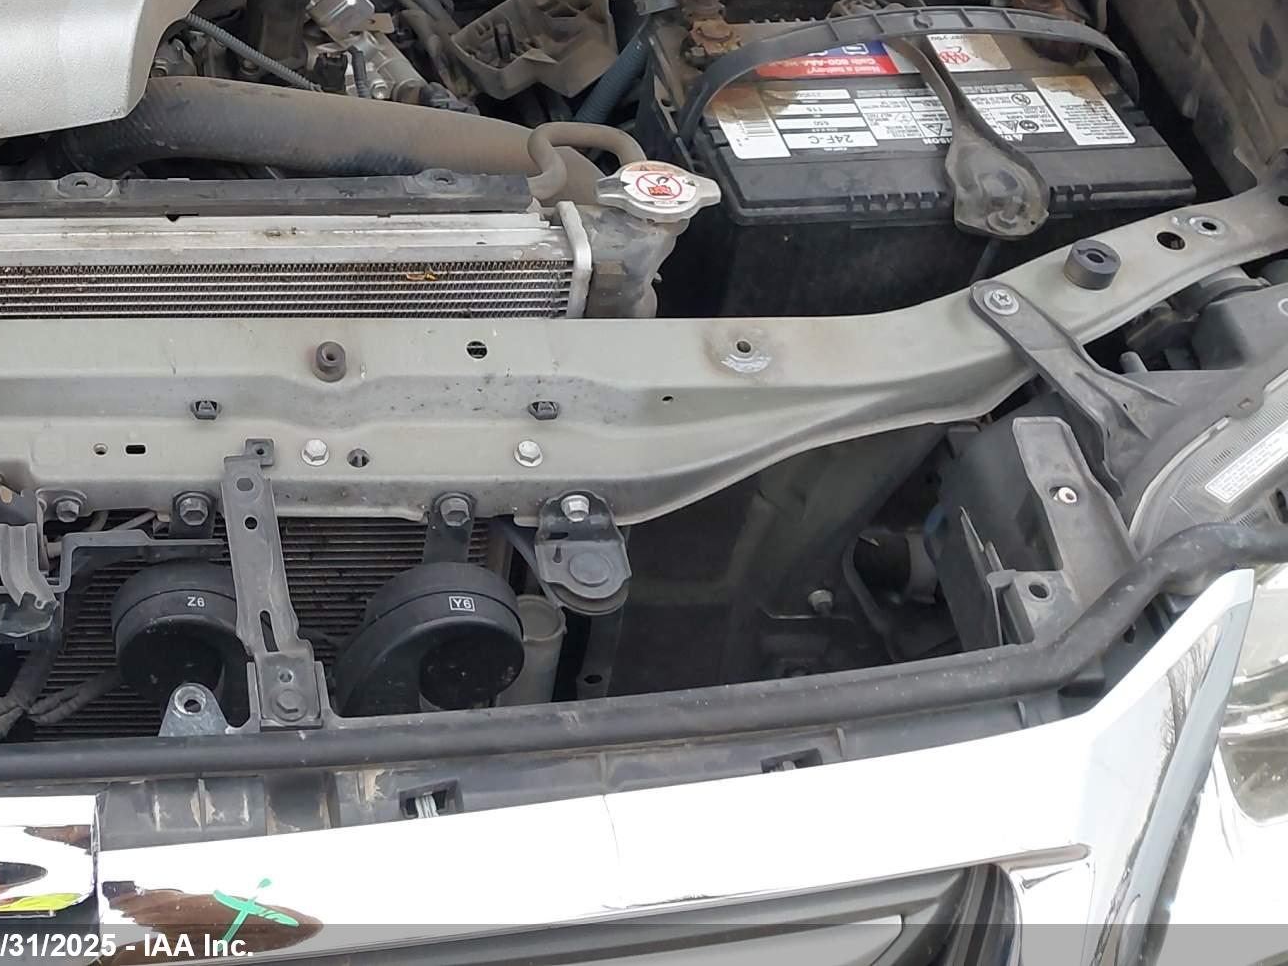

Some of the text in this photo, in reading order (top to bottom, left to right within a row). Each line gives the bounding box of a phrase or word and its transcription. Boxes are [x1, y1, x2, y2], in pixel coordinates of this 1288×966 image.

[807, 134, 854, 145] 24F-C
[186, 595, 206, 609] Z6
[451, 597, 474, 611] Y6
